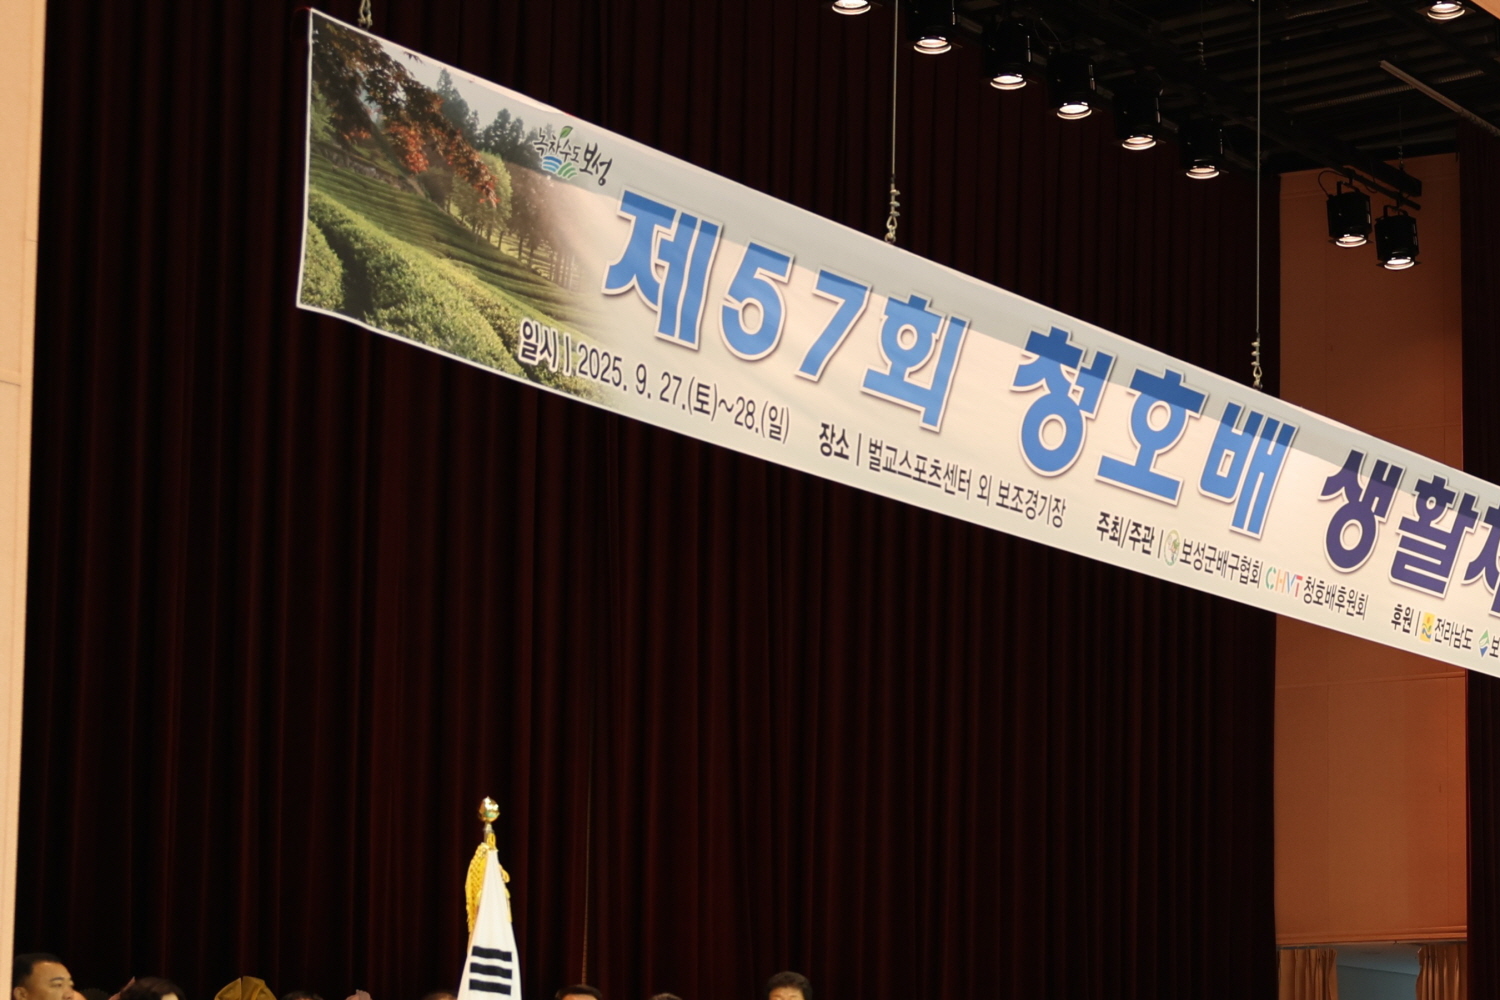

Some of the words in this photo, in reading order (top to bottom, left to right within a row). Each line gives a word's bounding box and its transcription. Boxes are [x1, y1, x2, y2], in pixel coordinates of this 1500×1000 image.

[533, 127, 581, 163] 녹차수도
[579, 143, 613, 186] 보성
[602, 189, 972, 432] 제57회
[1010, 326, 1299, 538] 청호배
[636, 363, 652, 399] 9.
[819, 423, 850, 460] 장소
[868, 437, 972, 500] 벌교스포츠센터
[976, 474, 993, 506] 외
[995, 479, 1067, 529] 보조경기장
[1179, 538, 1264, 589] 보성군배구협회
[1303, 575, 1369, 620] 청호배후원회
[1433, 617, 1474, 650] 전라남도
